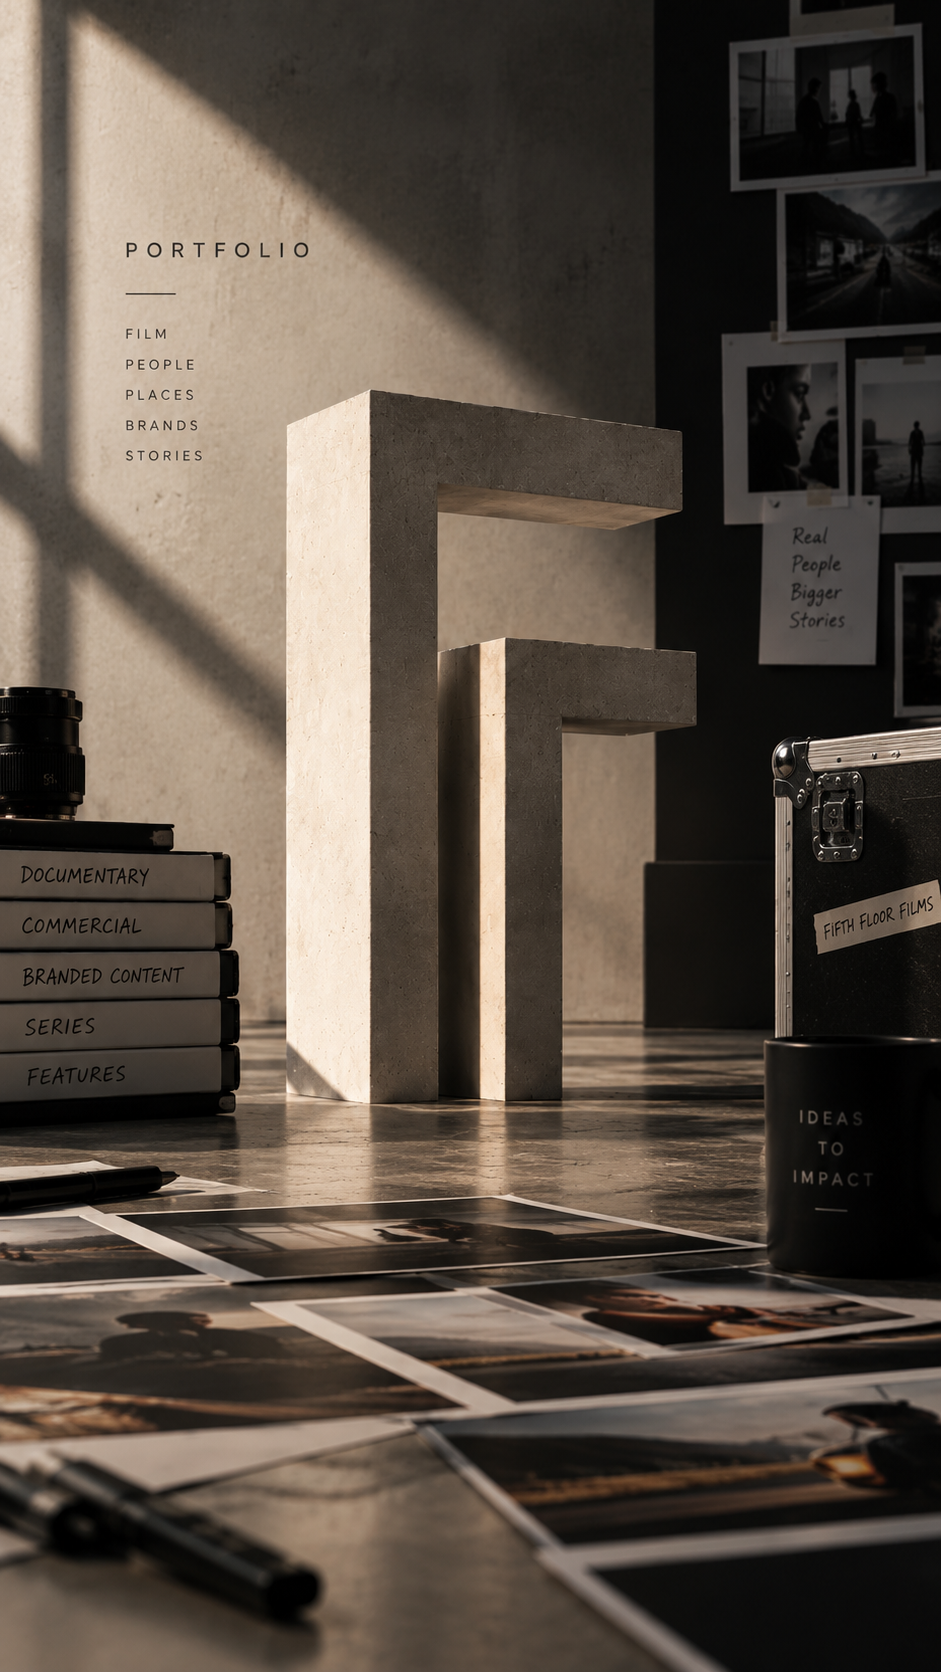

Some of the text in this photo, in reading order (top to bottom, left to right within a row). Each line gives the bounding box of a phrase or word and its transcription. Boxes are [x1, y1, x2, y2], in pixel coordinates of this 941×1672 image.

[125, 242, 309, 258] PORTFOLIO
[125, 328, 167, 340] FILM
[125, 359, 195, 371] PEOPLE
[125, 389, 195, 401] PLACES
[125, 420, 199, 432] BRANDS
[125, 450, 203, 462] STORIES
[792, 526, 828, 545] Real
[792, 554, 842, 578] People
[791, 582, 843, 607] Bigger
[789, 611, 846, 629] Stories
[20, 865, 150, 887] DOCUMENTARY
[859, 906, 895, 931] FLOOR
[899, 895, 934, 921] FILMS
[21, 916, 142, 934] COMMERCIAL
[22, 966, 185, 987] BRANDED CONTENT
[24, 1017, 95, 1036] SERIES
[27, 1065, 126, 1087] FEATURES
[799, 1109, 863, 1126] IDEAS
[818, 1141, 844, 1156] TO
[793, 1169, 874, 1187] IMPACT
